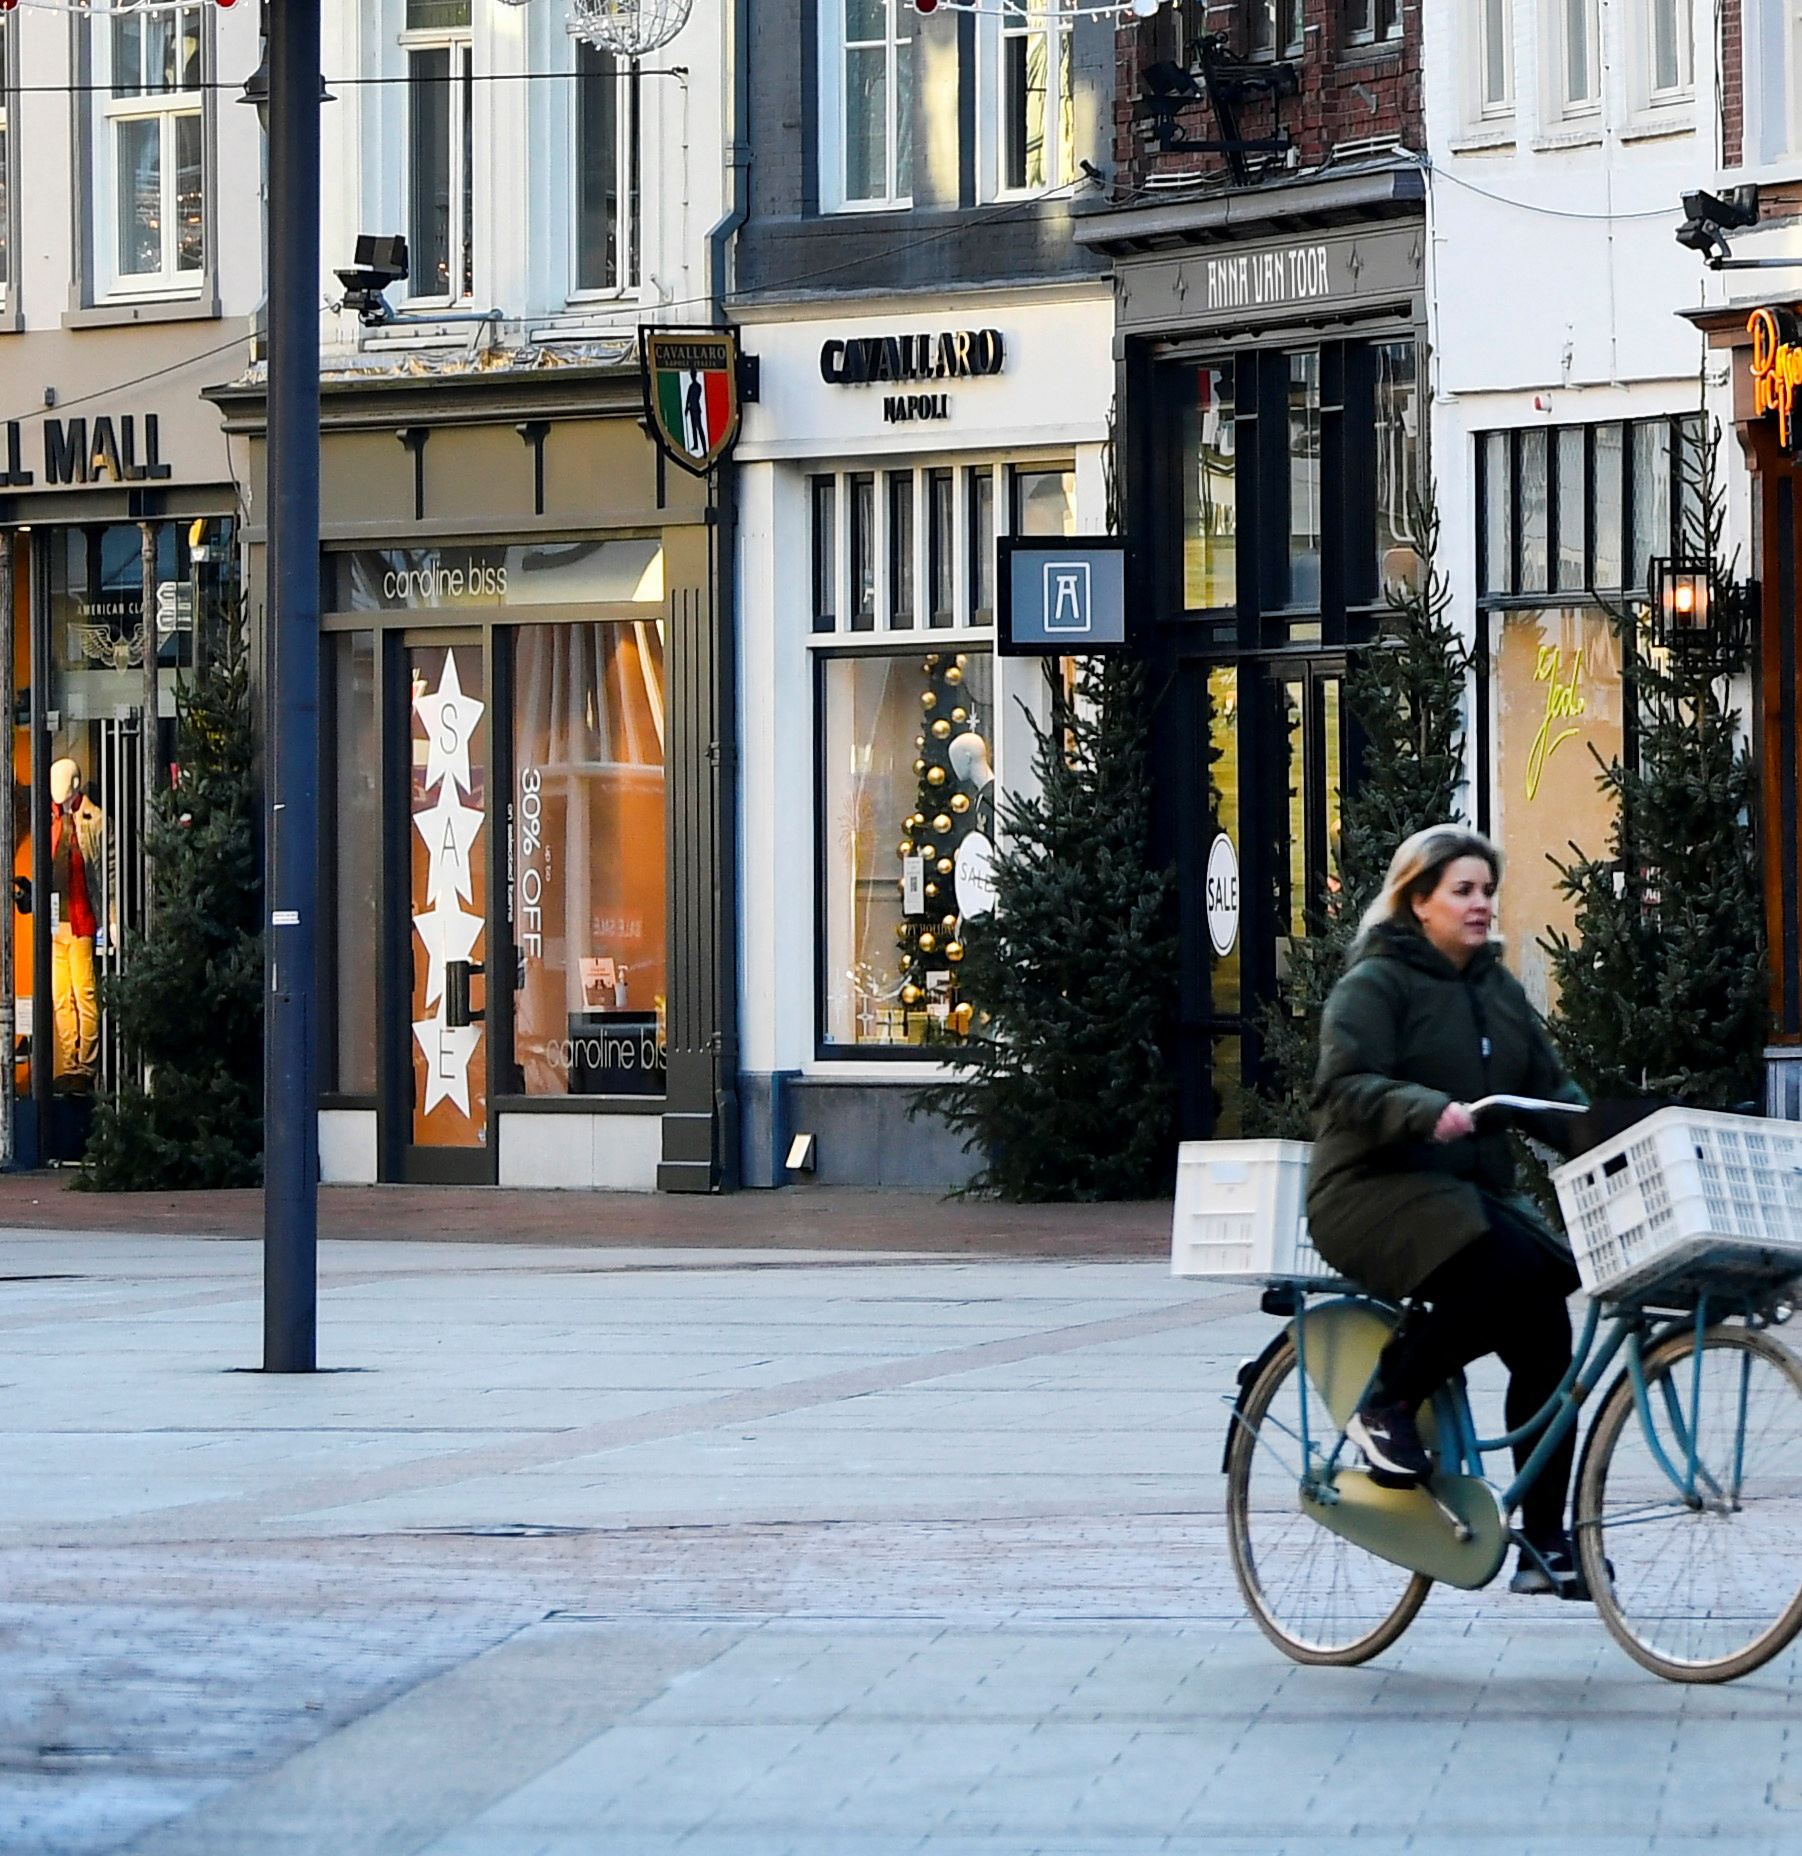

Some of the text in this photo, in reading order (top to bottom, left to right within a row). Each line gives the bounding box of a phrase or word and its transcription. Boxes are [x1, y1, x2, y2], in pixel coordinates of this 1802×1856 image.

[1207, 245, 1330, 309] ANNA VAN TOOR
[655, 345, 726, 360] CAVALLARO
[819, 328, 1005, 385] CAVALLARO
[883, 394, 951, 423] NAPOLI
[43, 413, 172, 485] MALL
[383, 555, 508, 599] caroline biss
[521, 767, 542, 959] 30% OFF
[1208, 876, 1237, 912] SALE
[546, 1027, 635, 1070] caroline
